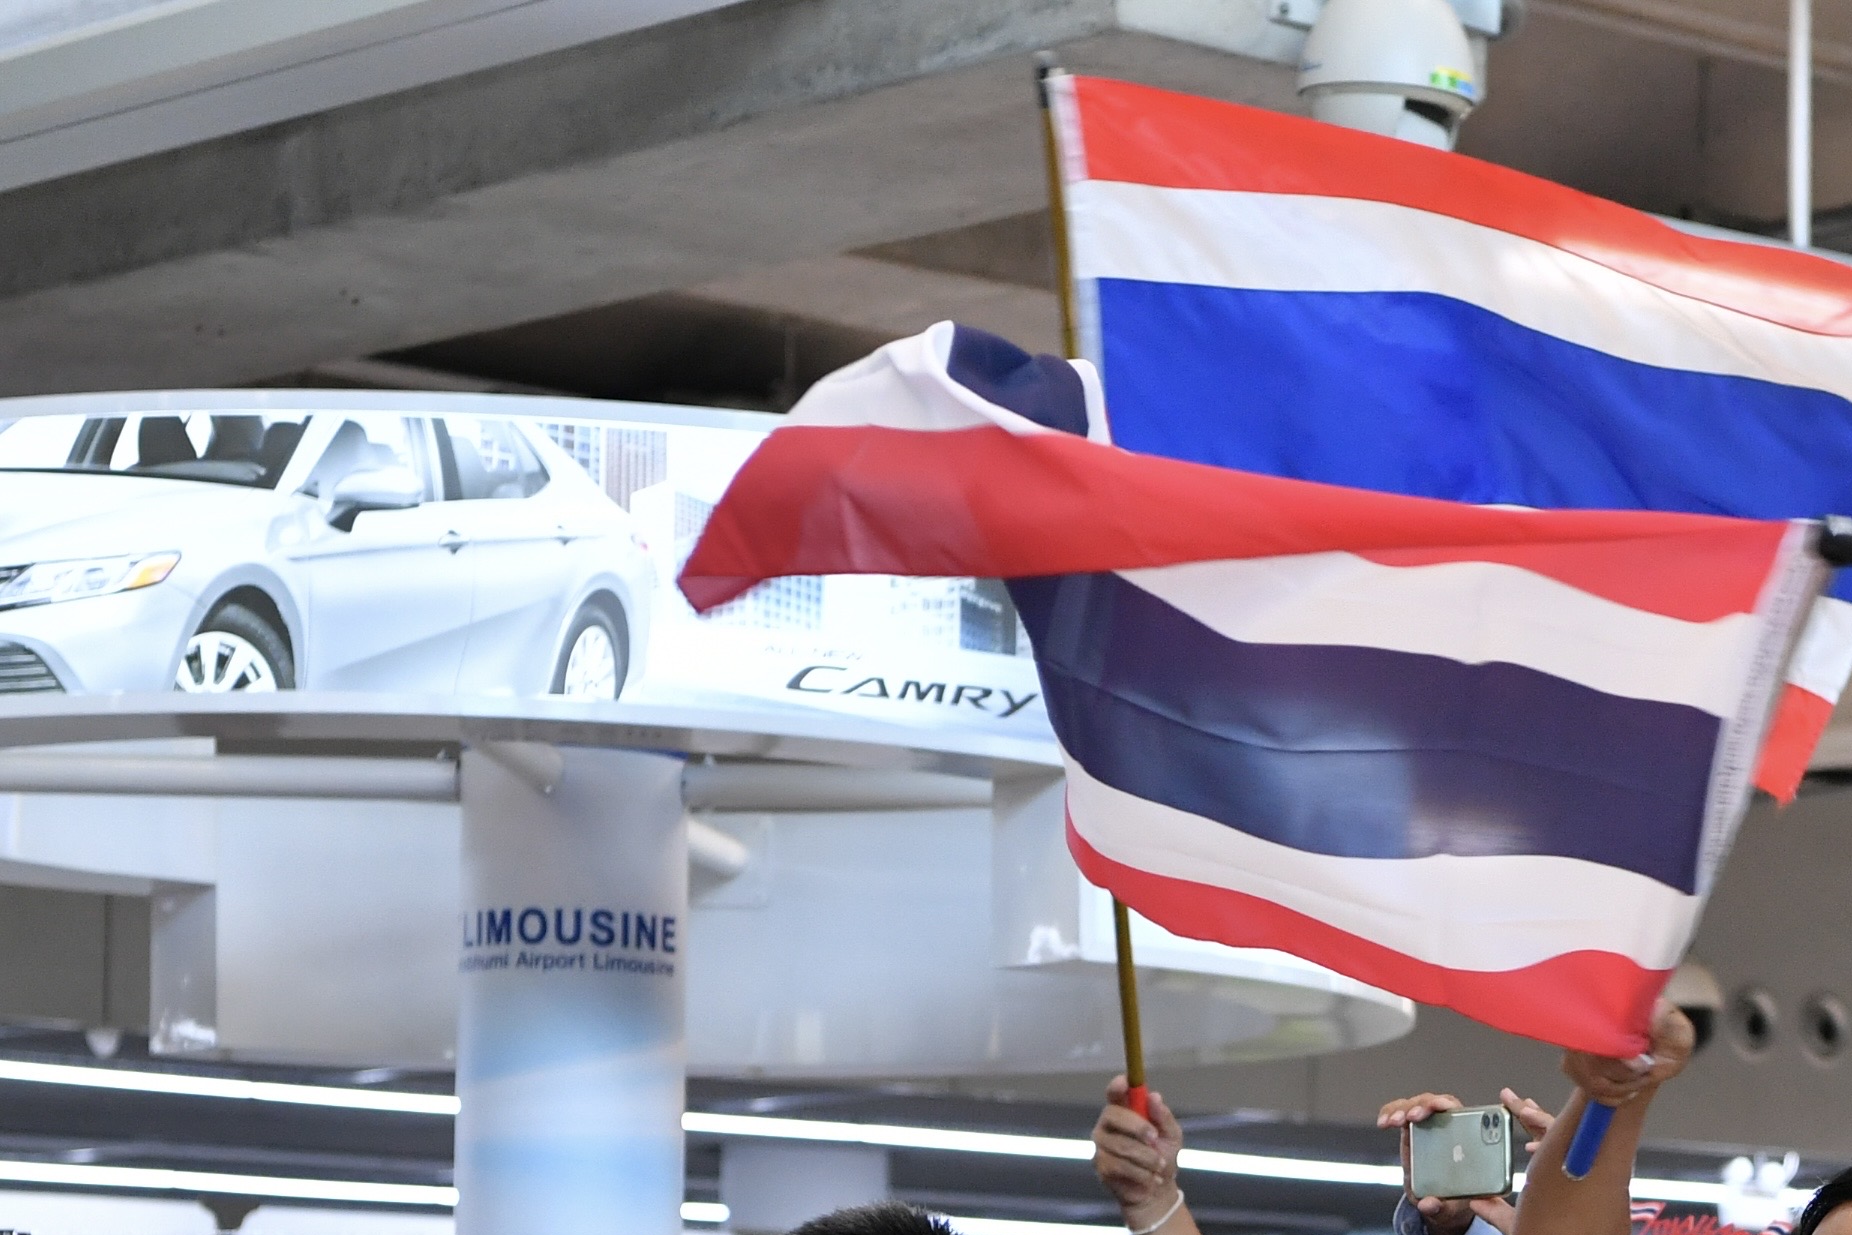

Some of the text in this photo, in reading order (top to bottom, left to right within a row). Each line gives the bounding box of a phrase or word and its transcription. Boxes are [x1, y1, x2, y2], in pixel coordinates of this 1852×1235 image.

[786, 665, 1038, 717] CAMRY
[463, 908, 675, 952] LIMOUSINE
[516, 951, 586, 972] Airport
